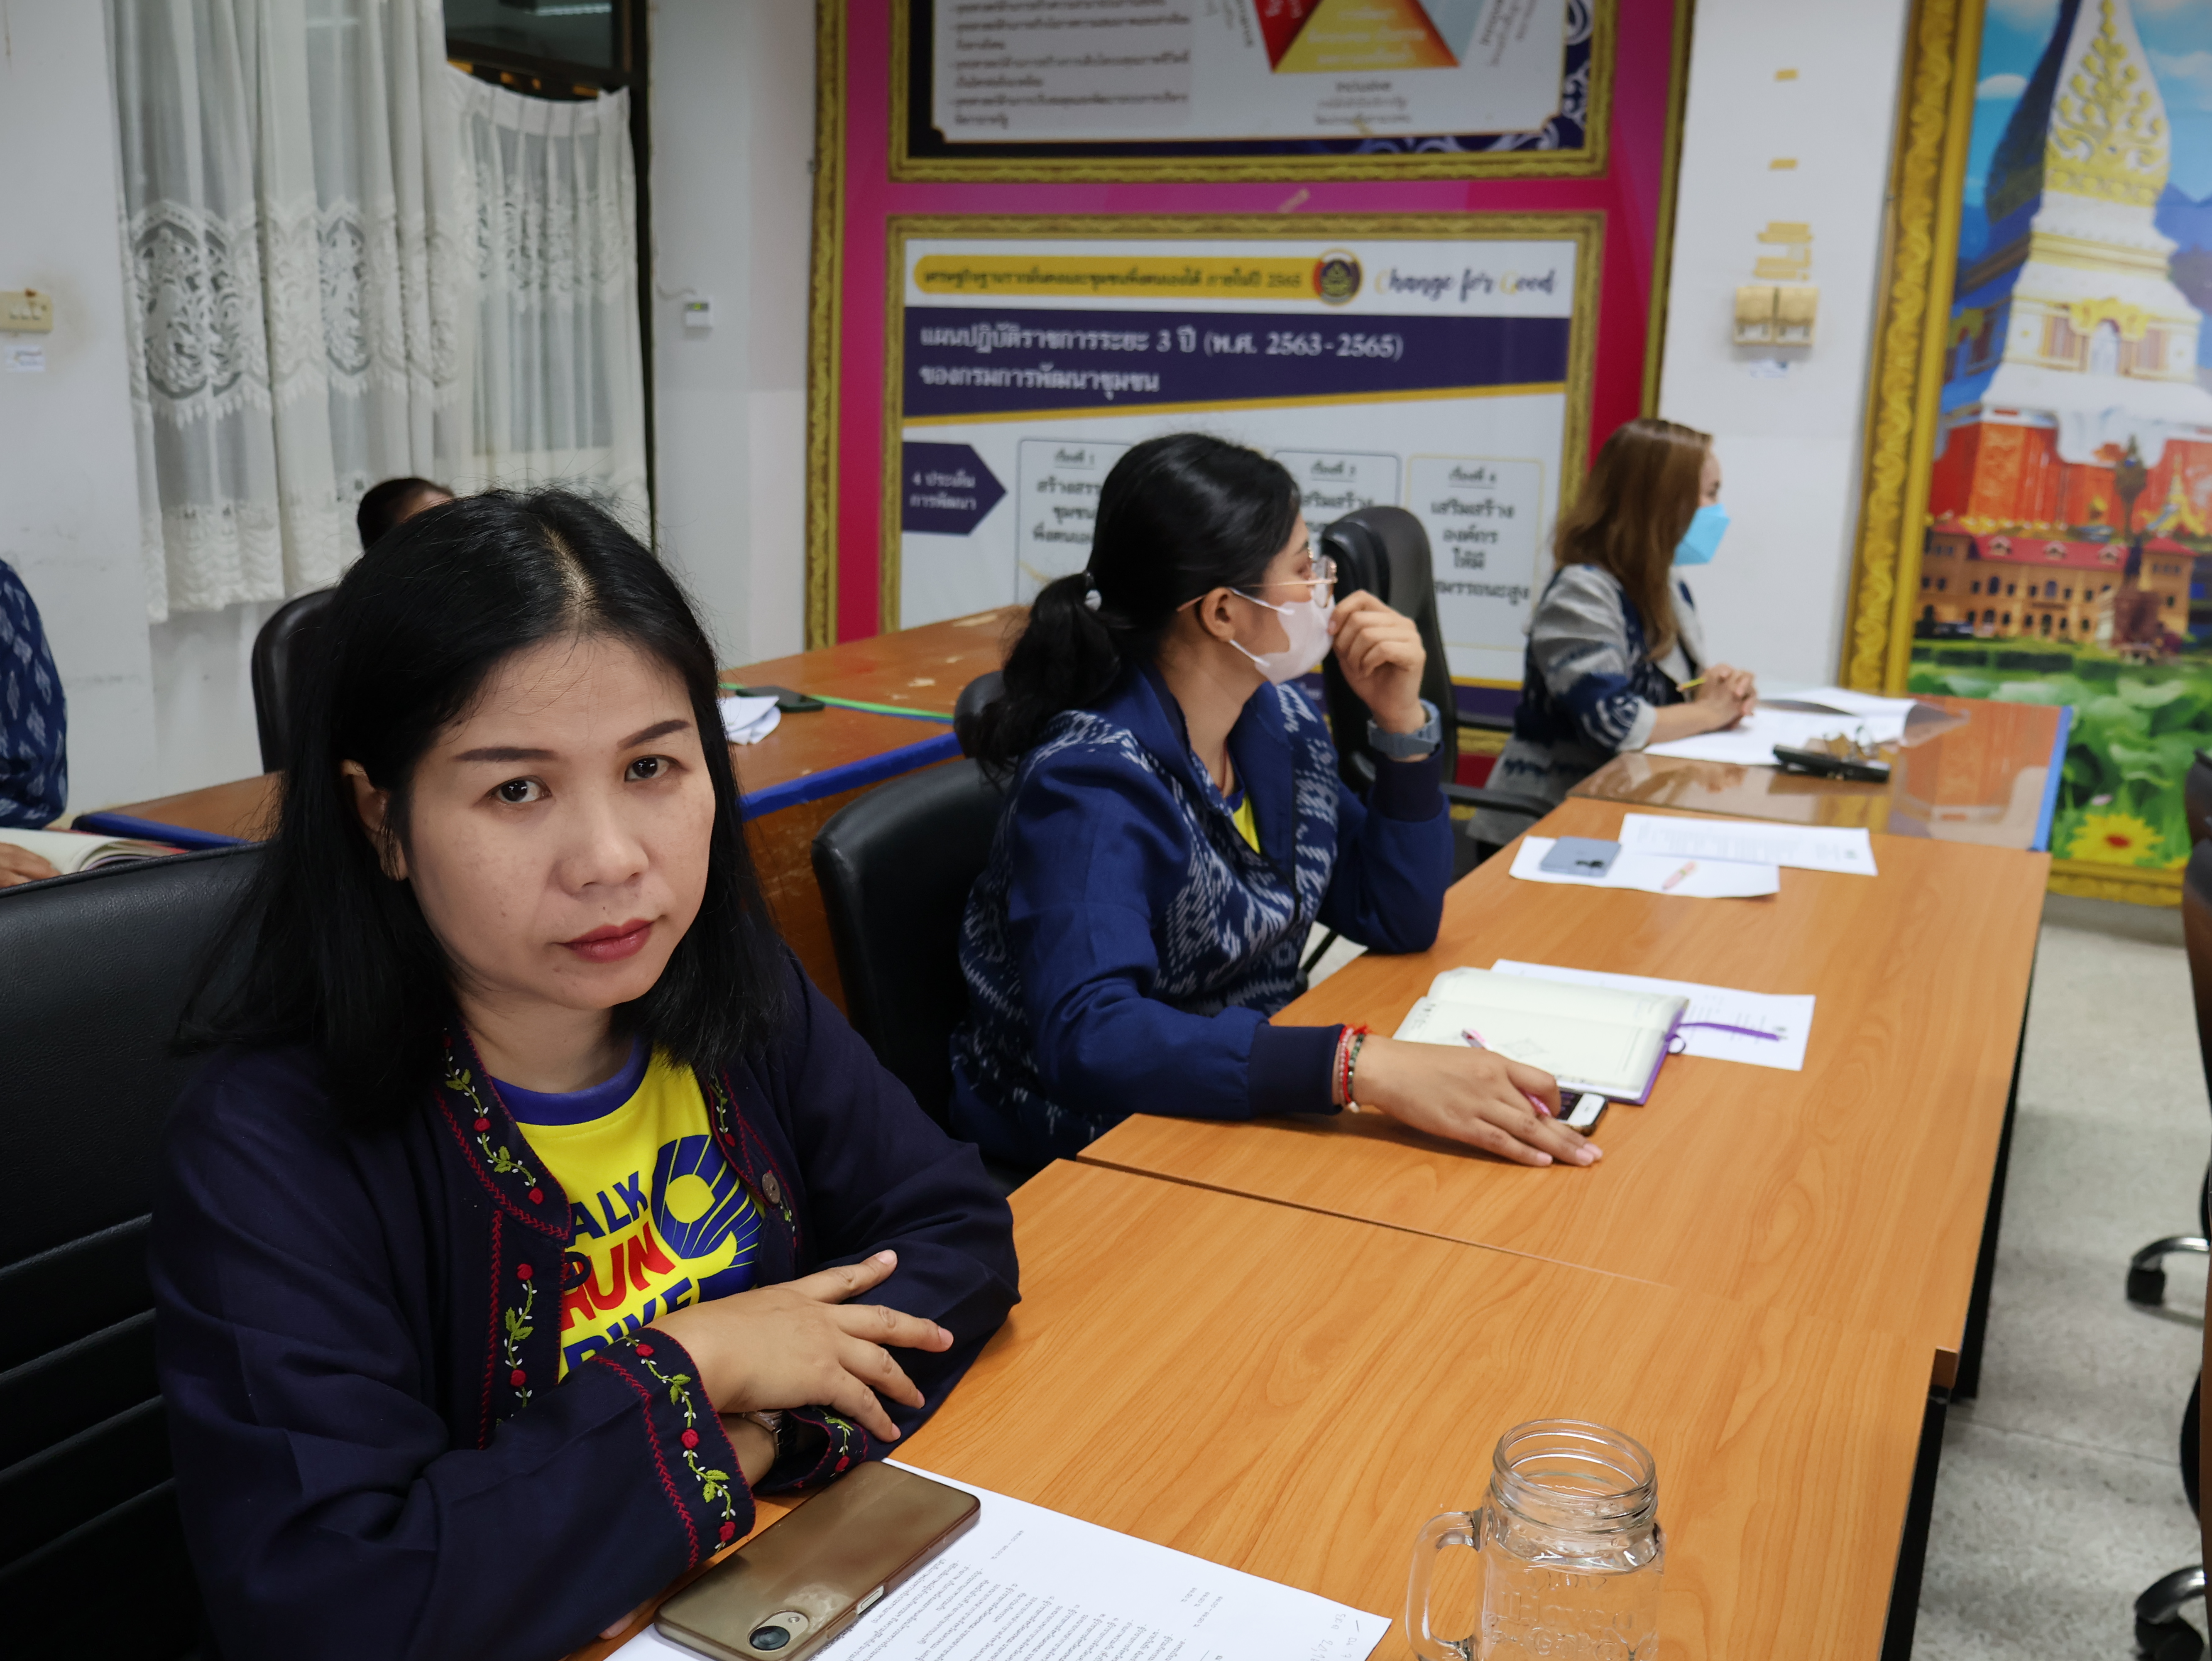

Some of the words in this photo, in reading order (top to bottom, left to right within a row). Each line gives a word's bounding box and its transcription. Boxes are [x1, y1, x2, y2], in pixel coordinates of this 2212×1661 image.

[1156, 330, 1171, 352] 3
[1176, 324, 1196, 353] ปี
[919, 361, 1160, 400] ของกรมการพัฒนาชุมชน
[565, 1171, 648, 1247] ALK
[1111, 1627, 1147, 1661] ผู้ว่าราชการจังหวัด
